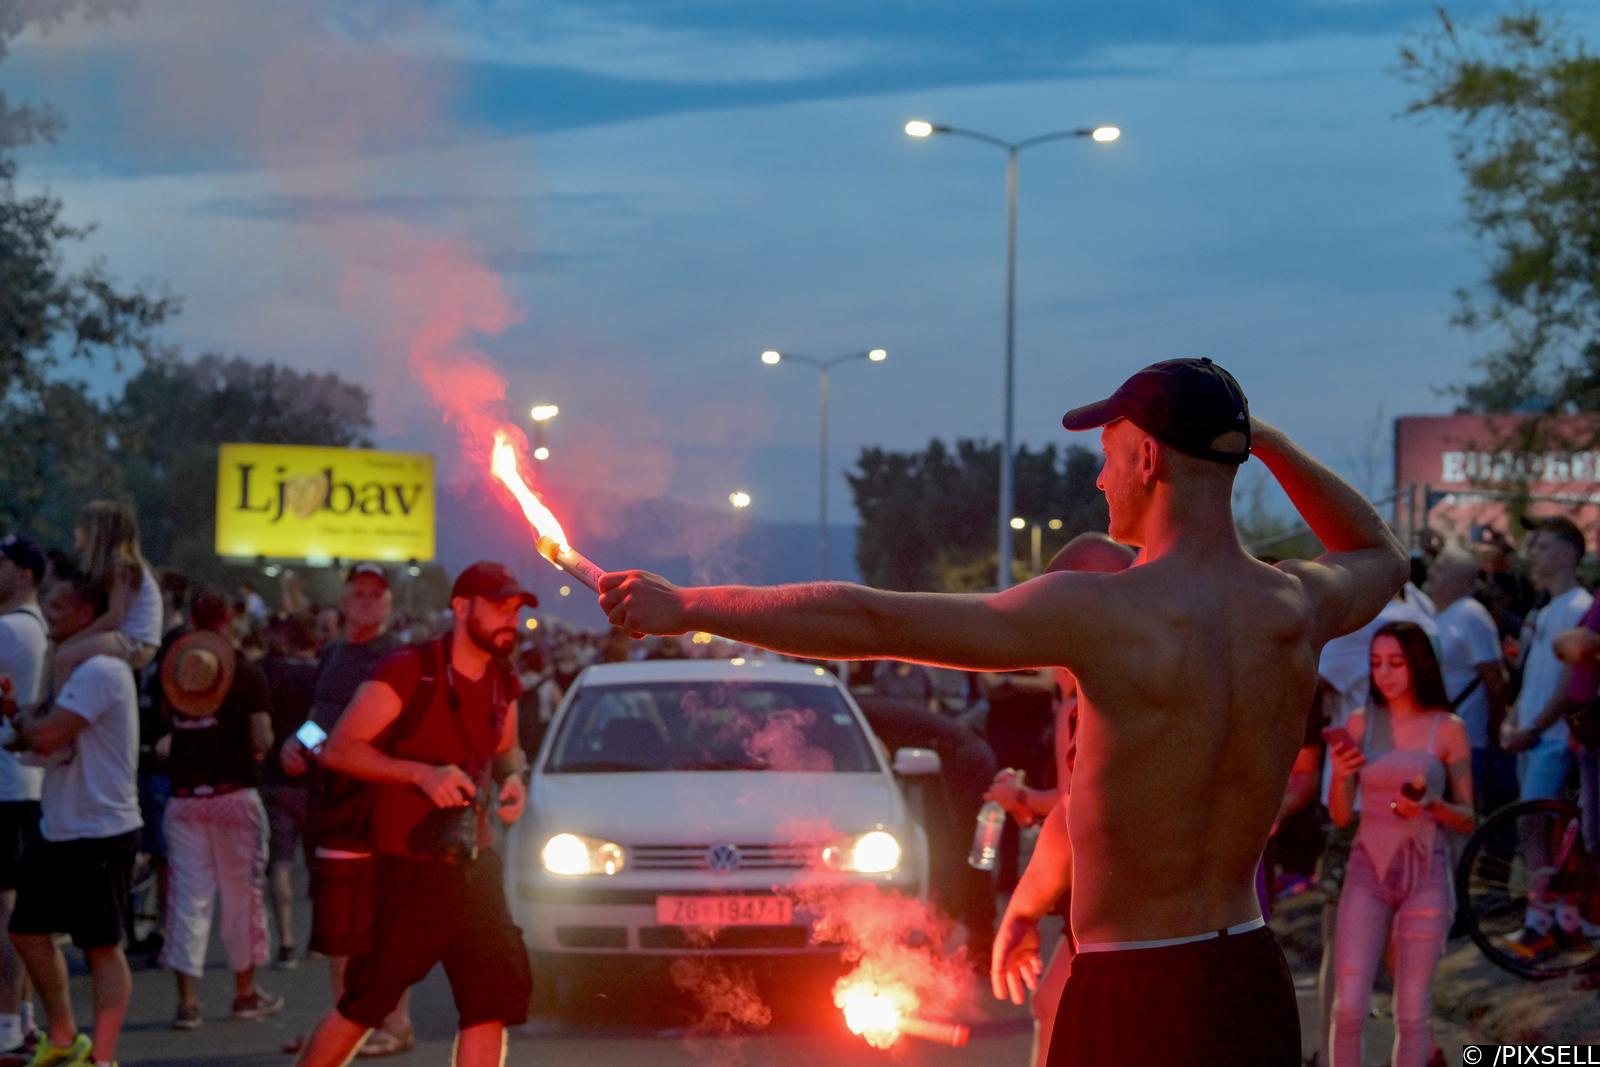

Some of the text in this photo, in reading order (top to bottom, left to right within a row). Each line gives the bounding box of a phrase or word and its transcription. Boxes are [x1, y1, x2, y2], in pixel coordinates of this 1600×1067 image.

[1442, 451, 1600, 482] EUROHE
[237, 463, 423, 524] Ljbav
[672, 901, 698, 921] ZG
